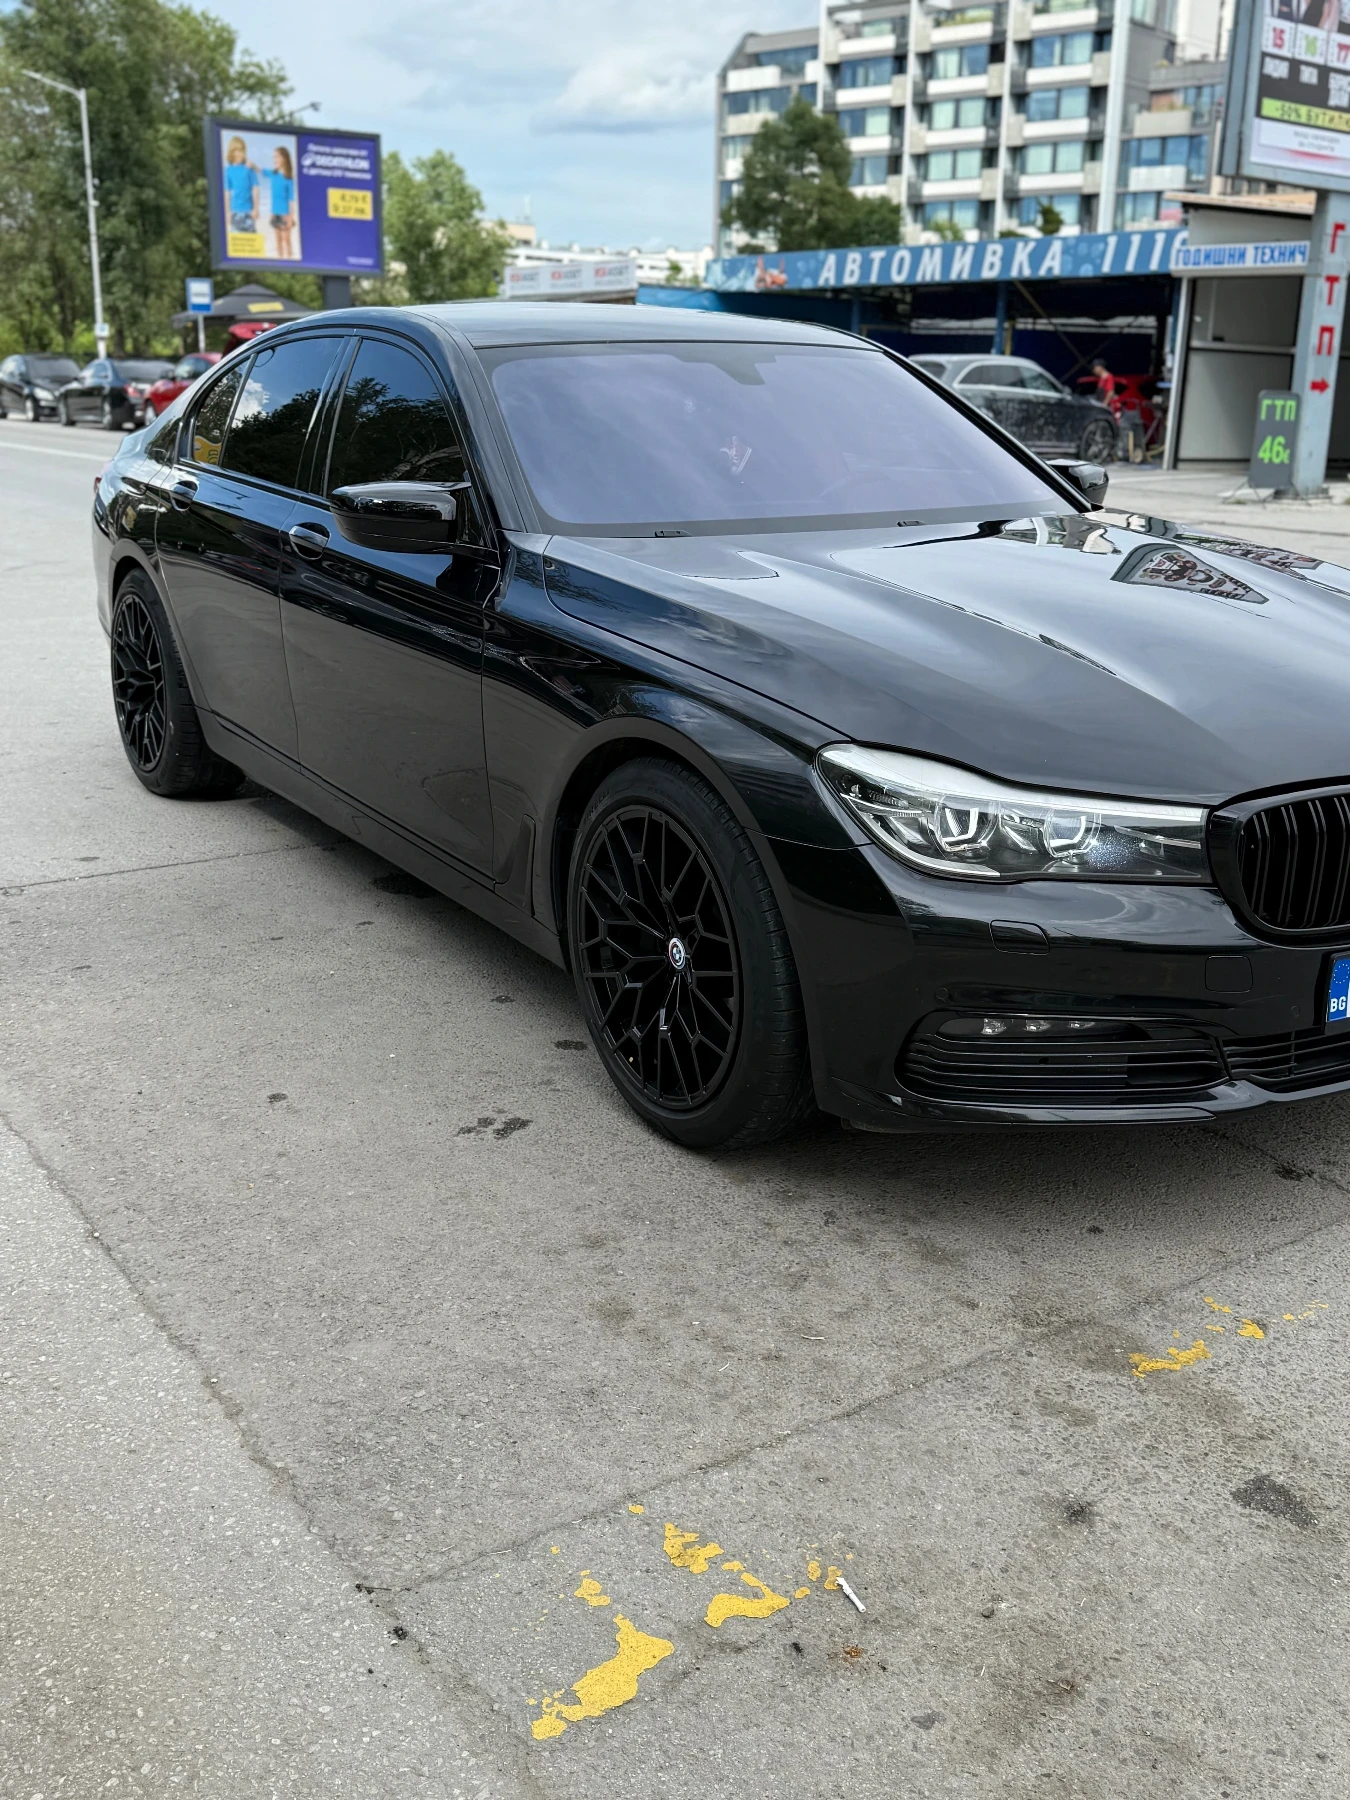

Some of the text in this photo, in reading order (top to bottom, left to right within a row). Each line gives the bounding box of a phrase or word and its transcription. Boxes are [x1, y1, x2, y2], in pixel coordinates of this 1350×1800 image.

[817, 239, 1063, 287] АВТОМИВКА
[1175, 246, 1247, 267] ГОДИШНИ
[1260, 399, 1297, 421] ГТП
[1329, 996, 1347, 1012] BG
